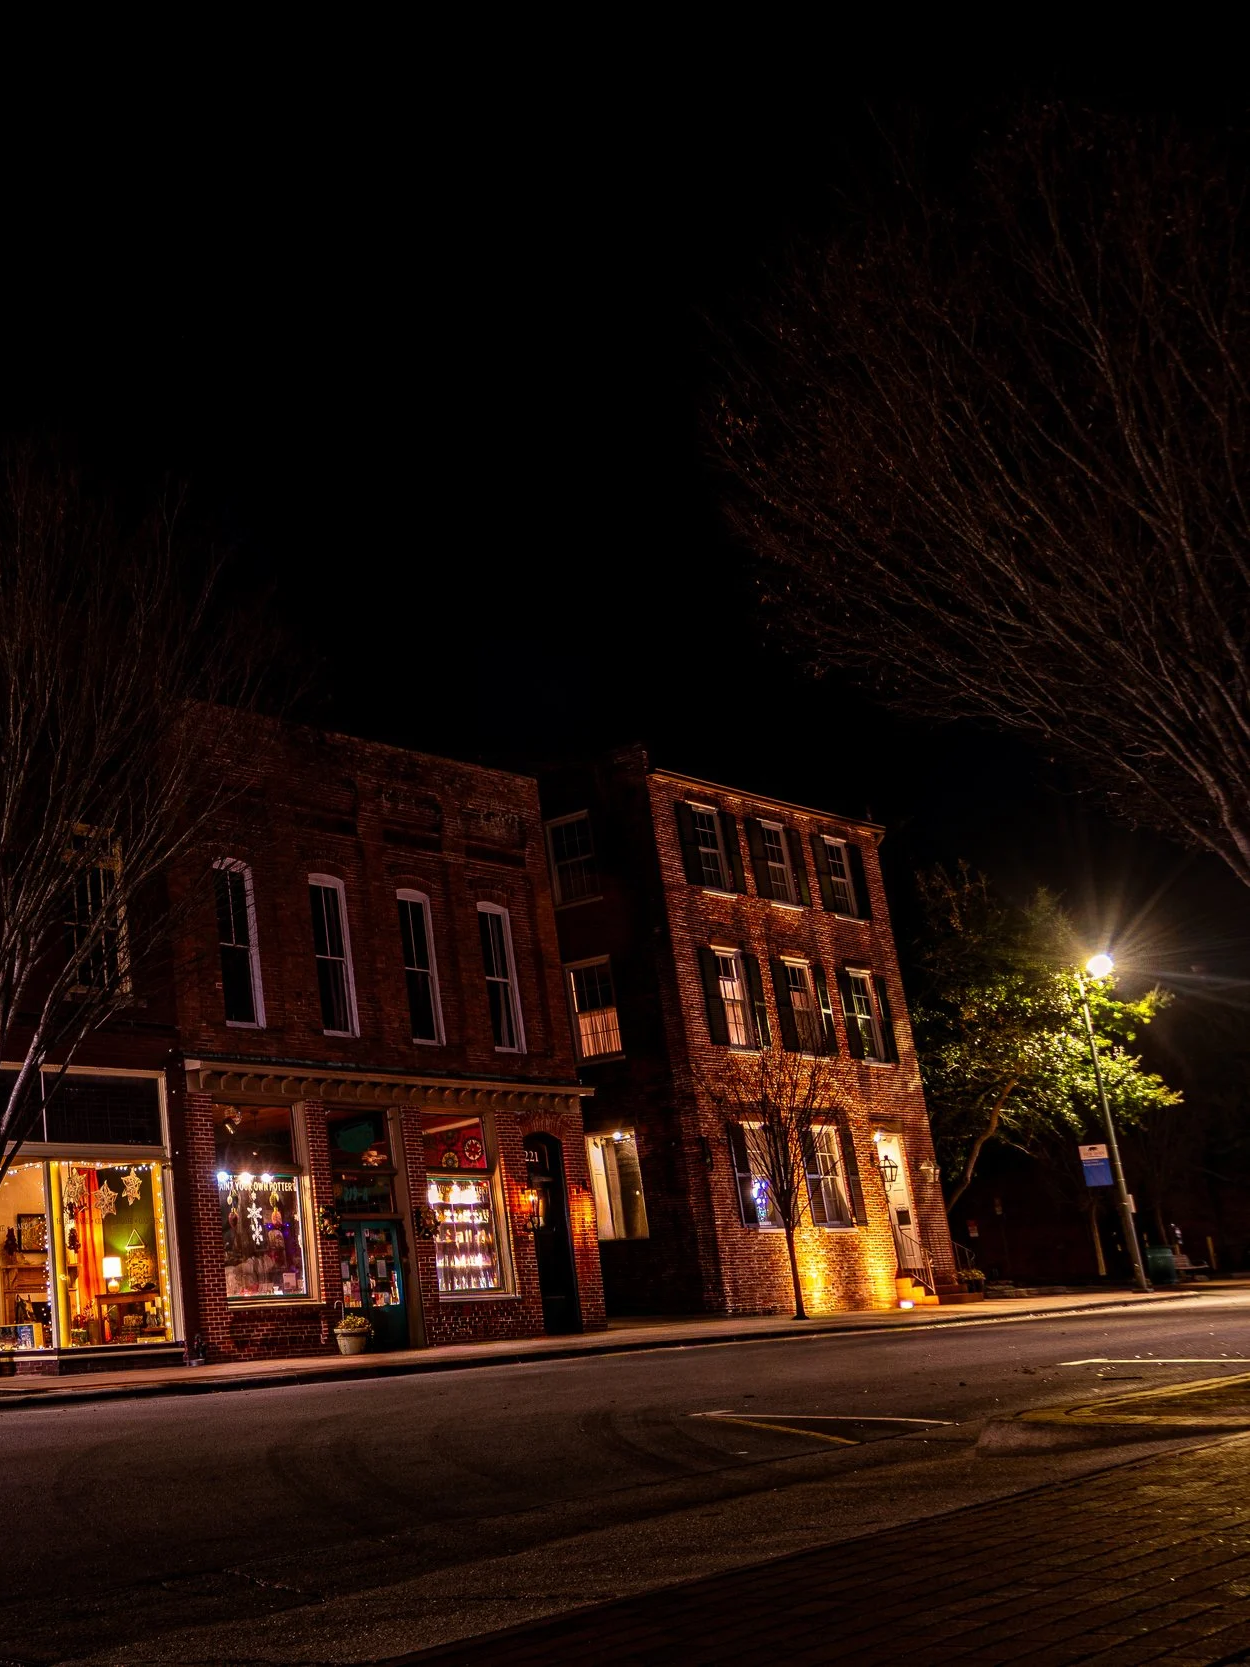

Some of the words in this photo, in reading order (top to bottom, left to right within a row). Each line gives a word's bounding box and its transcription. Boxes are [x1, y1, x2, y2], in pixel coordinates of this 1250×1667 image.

[524, 1150, 539, 1163] 221
[218, 1181, 234, 1191] AINT
[253, 1181, 269, 1191] OWN
